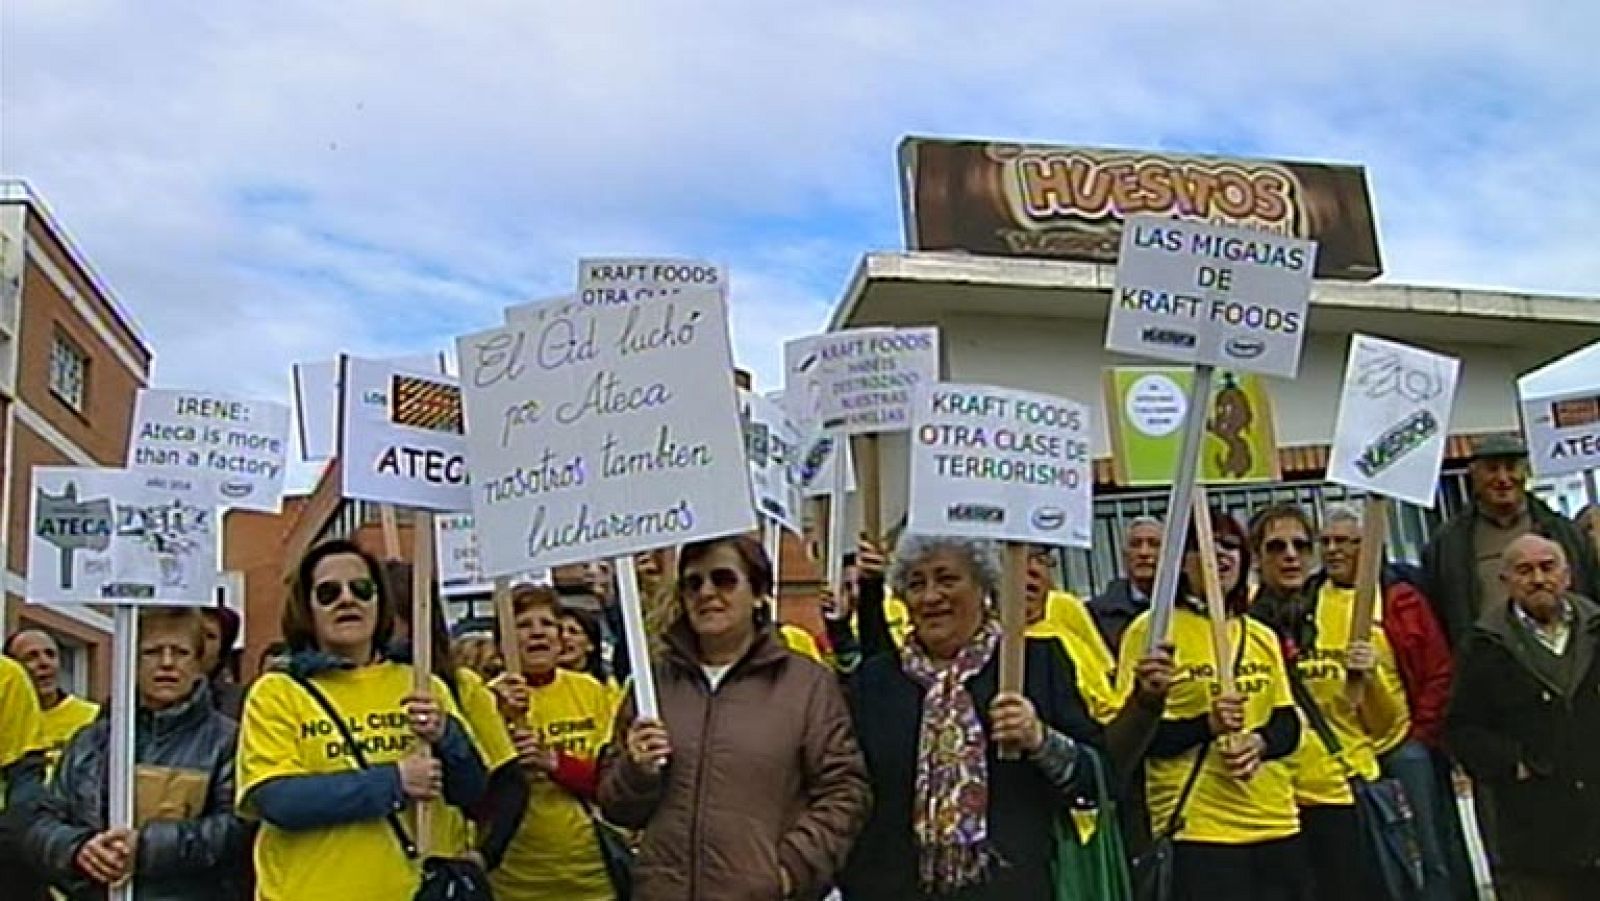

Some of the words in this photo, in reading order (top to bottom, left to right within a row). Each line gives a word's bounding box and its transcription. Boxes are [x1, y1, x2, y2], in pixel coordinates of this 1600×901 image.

[1025, 158, 1289, 221] HUESITOS
[1134, 225, 1182, 254] LAS
[1190, 231, 1304, 271] MIGAJAS
[591, 264, 647, 282] KRAFT
[653, 264, 718, 284] FOODS
[1198, 265, 1232, 292] DE
[582, 288, 629, 304] OTRA
[1119, 286, 1201, 319] KRAFT
[1208, 301, 1300, 335] FOODS
[474, 331, 526, 388] El
[537, 316, 601, 369] Cid
[619, 302, 701, 355] luchó
[176, 396, 249, 422] IRENE:
[556, 371, 672, 424] Ateca
[931, 391, 1009, 418] KRAFT
[1015, 400, 1081, 431] FOODS
[140, 422, 196, 442] Ateca
[203, 425, 220, 445] is
[227, 430, 281, 453] more
[919, 423, 986, 448] OTRA
[994, 428, 1061, 459] CLASE
[1066, 438, 1089, 464] DE
[136, 447, 180, 466] than
[185, 451, 199, 467] a
[207, 450, 280, 479] factory
[483, 448, 589, 504] nosotros
[599, 424, 714, 478] tambien
[932, 453, 1080, 490] TERRORISMO
[39, 517, 112, 536] ATECA
[528, 499, 693, 558] lucharemos
